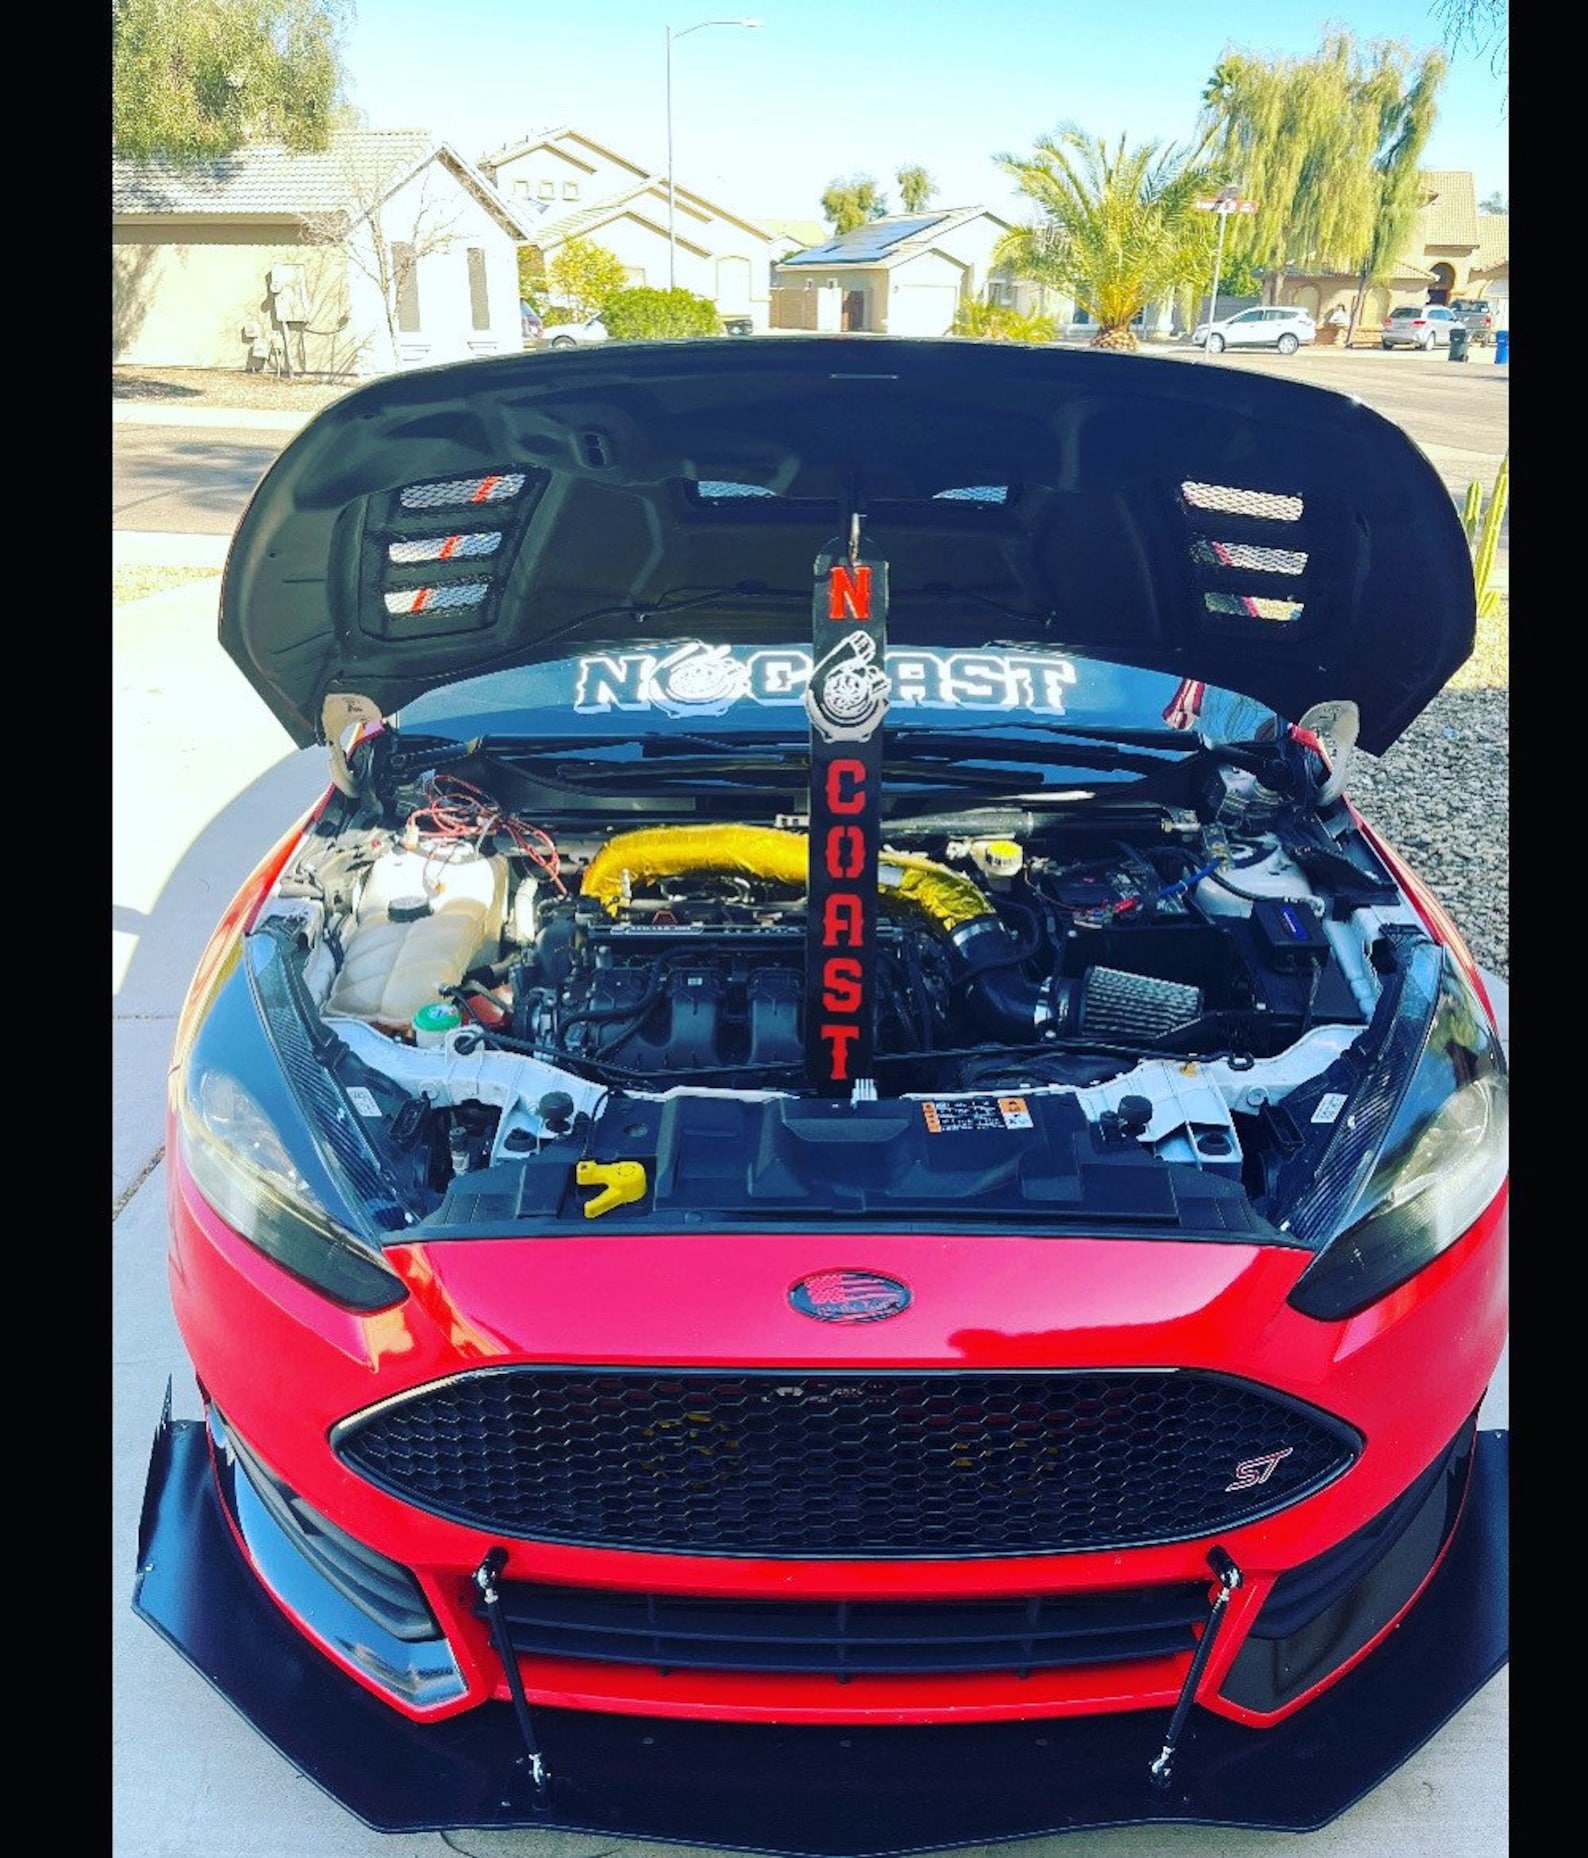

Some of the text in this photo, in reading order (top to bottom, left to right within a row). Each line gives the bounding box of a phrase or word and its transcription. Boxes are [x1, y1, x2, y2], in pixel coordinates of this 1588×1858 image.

[748, 650, 1077, 716] CAST
[821, 758, 866, 1080] COAST
[1225, 1447, 1293, 1492] ST
